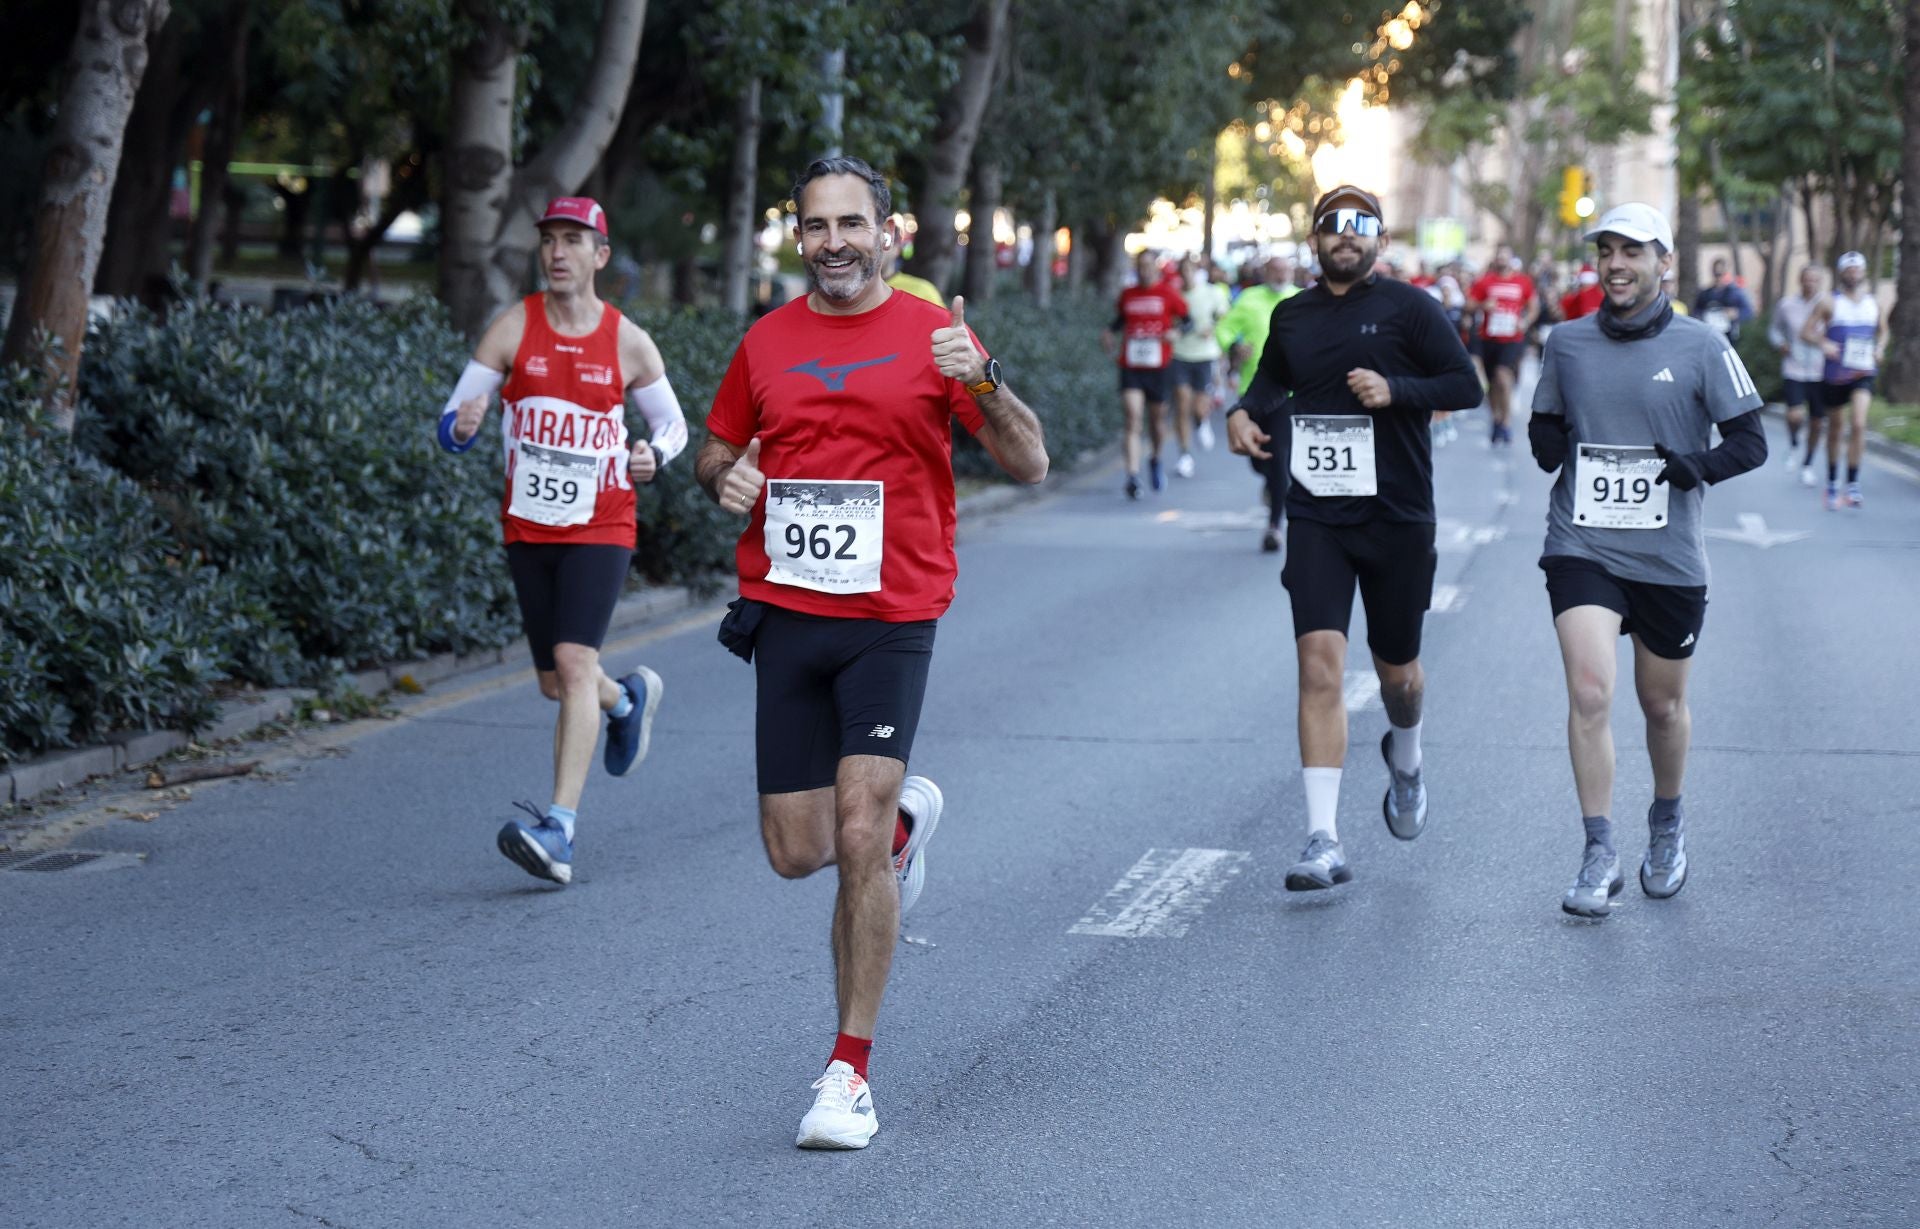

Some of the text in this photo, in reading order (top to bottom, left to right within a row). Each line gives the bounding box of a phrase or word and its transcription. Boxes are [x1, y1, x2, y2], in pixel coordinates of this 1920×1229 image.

[1307, 446, 1357, 471] 531
[526, 473, 579, 504] 359
[840, 498, 879, 506] XIV
[1593, 476, 1651, 504] 919
[785, 523, 858, 560] 962
